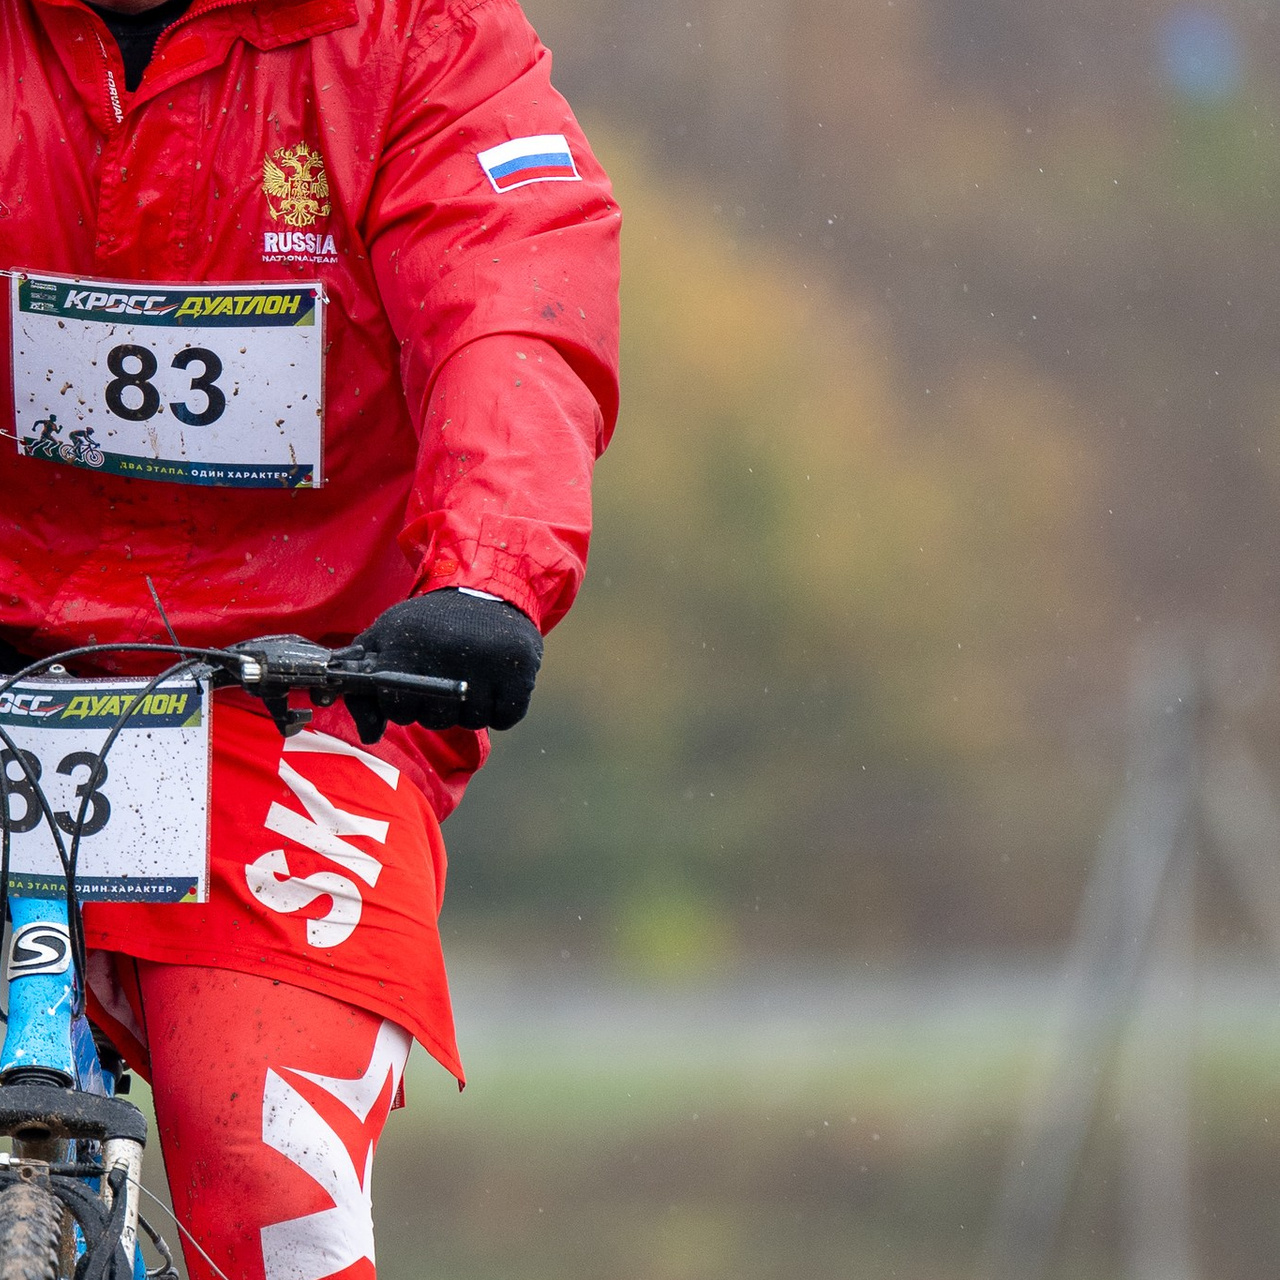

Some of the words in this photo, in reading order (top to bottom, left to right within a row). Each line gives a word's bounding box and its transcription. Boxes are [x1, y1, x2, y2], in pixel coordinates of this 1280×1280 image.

[264, 232, 338, 255] RUSSIA
[64, 290, 179, 316] КРОСС
[174, 295, 301, 318] ДУАТЛОН
[105, 344, 226, 426] 83
[120, 461, 143, 471] ДВА
[146, 465, 188, 475] ЭТАПА.
[191, 469, 224, 478] ОДИН
[227, 471, 292, 479] ХАРАКТЕР.
[60, 694, 188, 719] ДУАТЛОН
[75, 884, 108, 893] ОДИН
[111, 884, 177, 893] ХАРАКТЕР.
